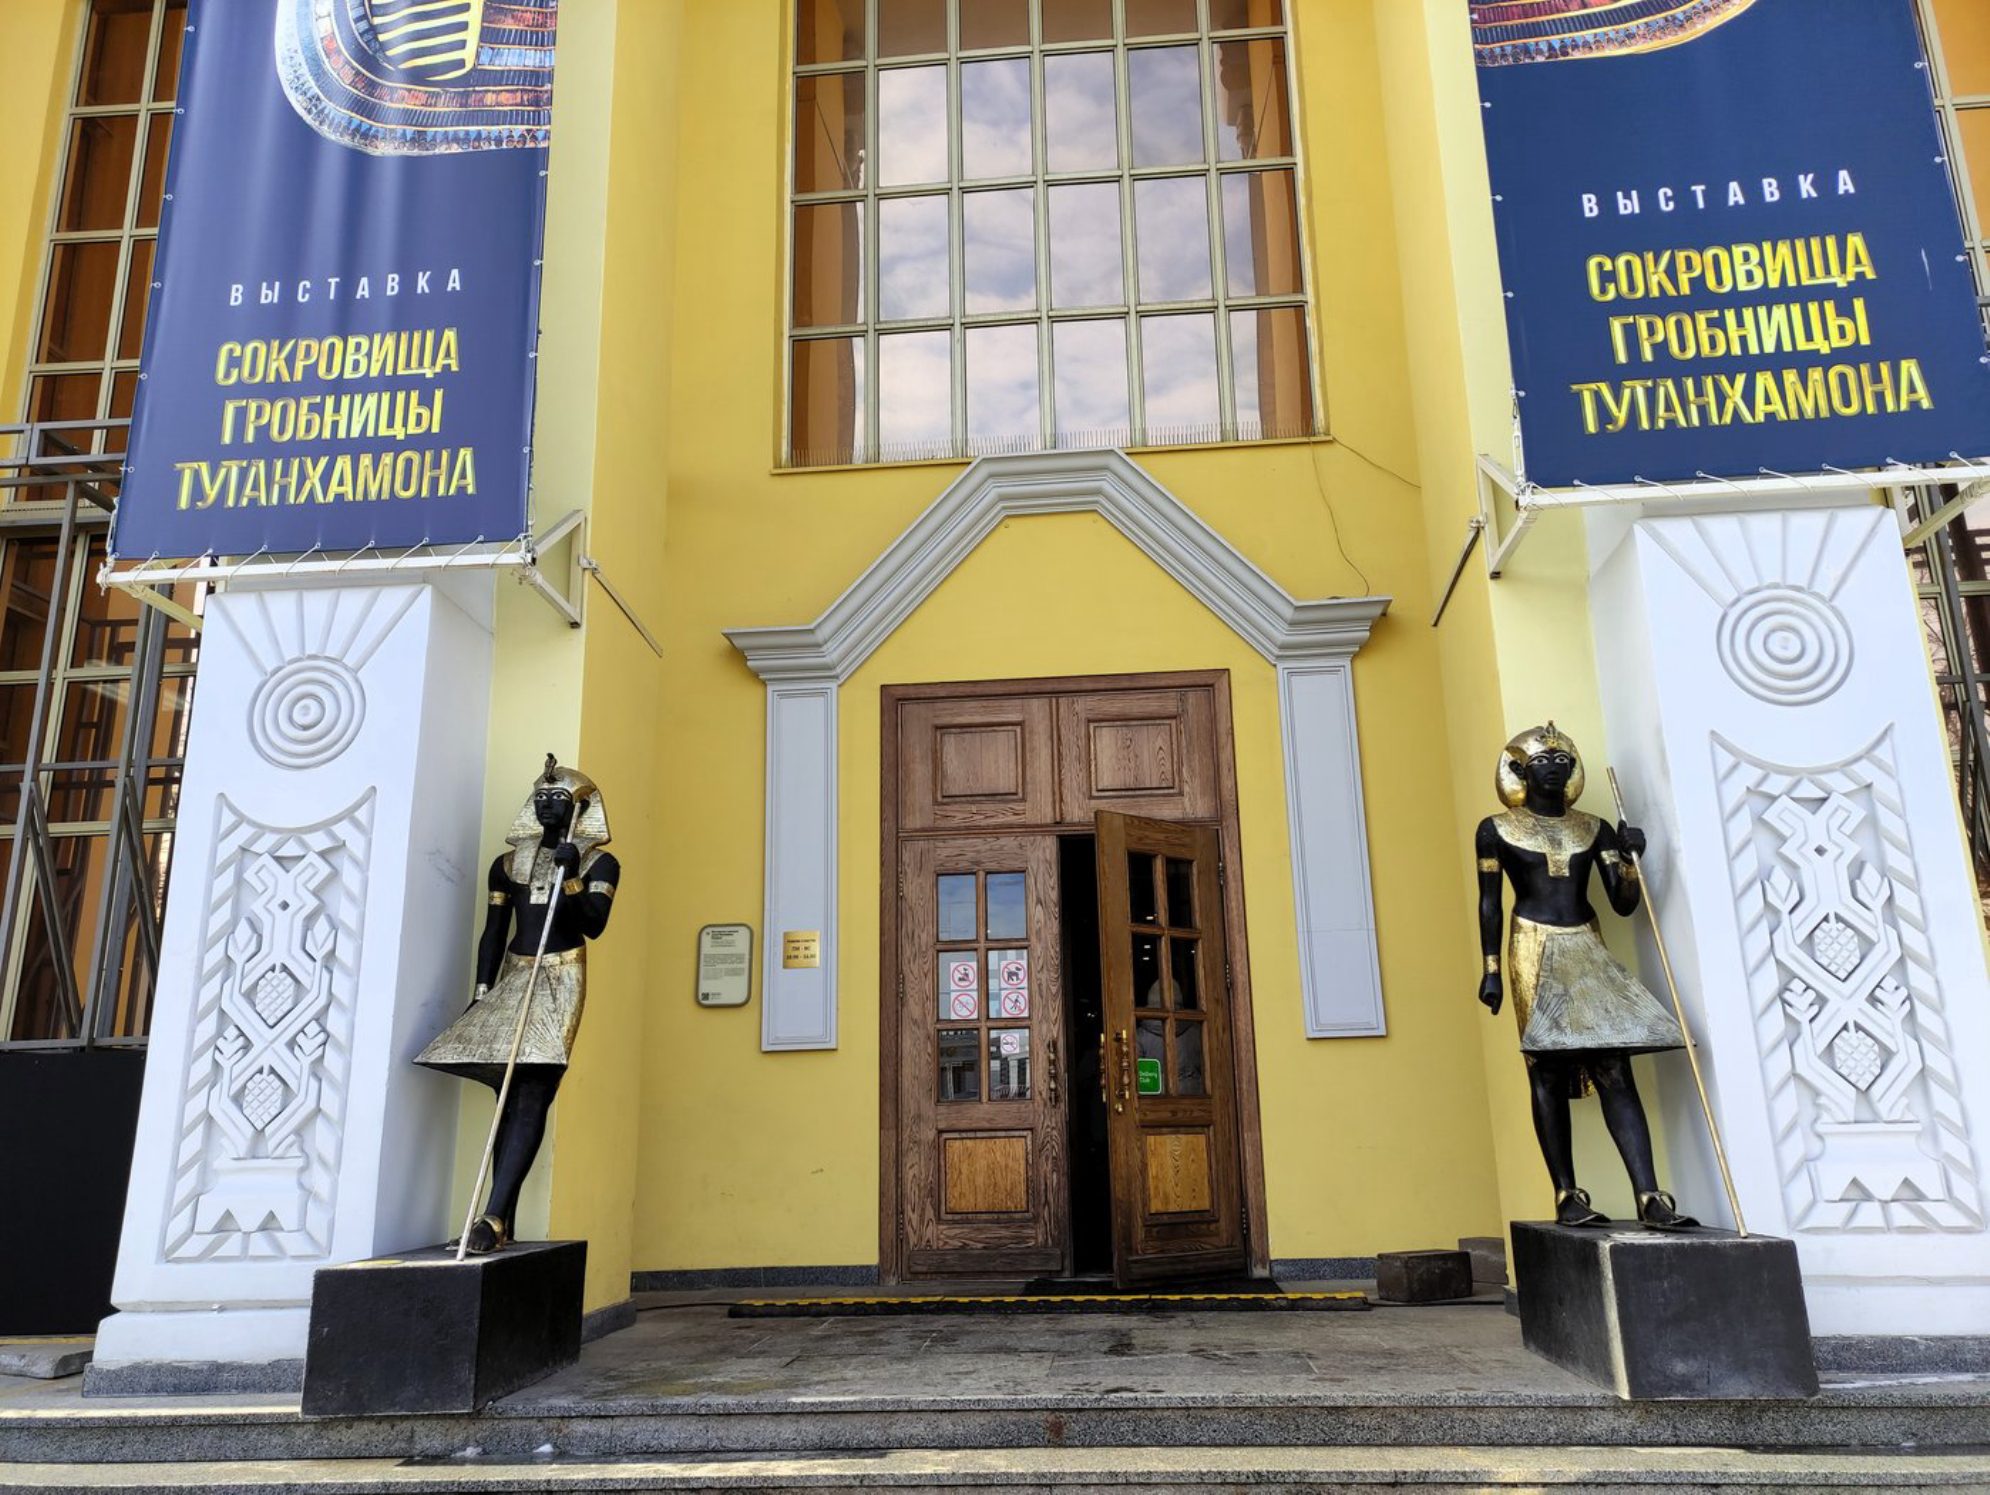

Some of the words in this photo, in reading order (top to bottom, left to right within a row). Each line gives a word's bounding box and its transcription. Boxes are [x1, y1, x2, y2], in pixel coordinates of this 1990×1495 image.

[1582, 170, 1855, 217] ВЫСТАВКА
[230, 268, 461, 306] ВЫСТАВКА
[1587, 232, 1877, 302] СОКРОВИЩА
[215, 327, 459, 386] СОКРОВИЩА
[1609, 297, 1872, 364] ГРОБНИЦЫ
[221, 388, 444, 445] ГРОБНИЦЫ
[1570, 358, 1934, 435] ТУТАНХАМОНА
[174, 446, 477, 510] ТУТАНХАМОНА
